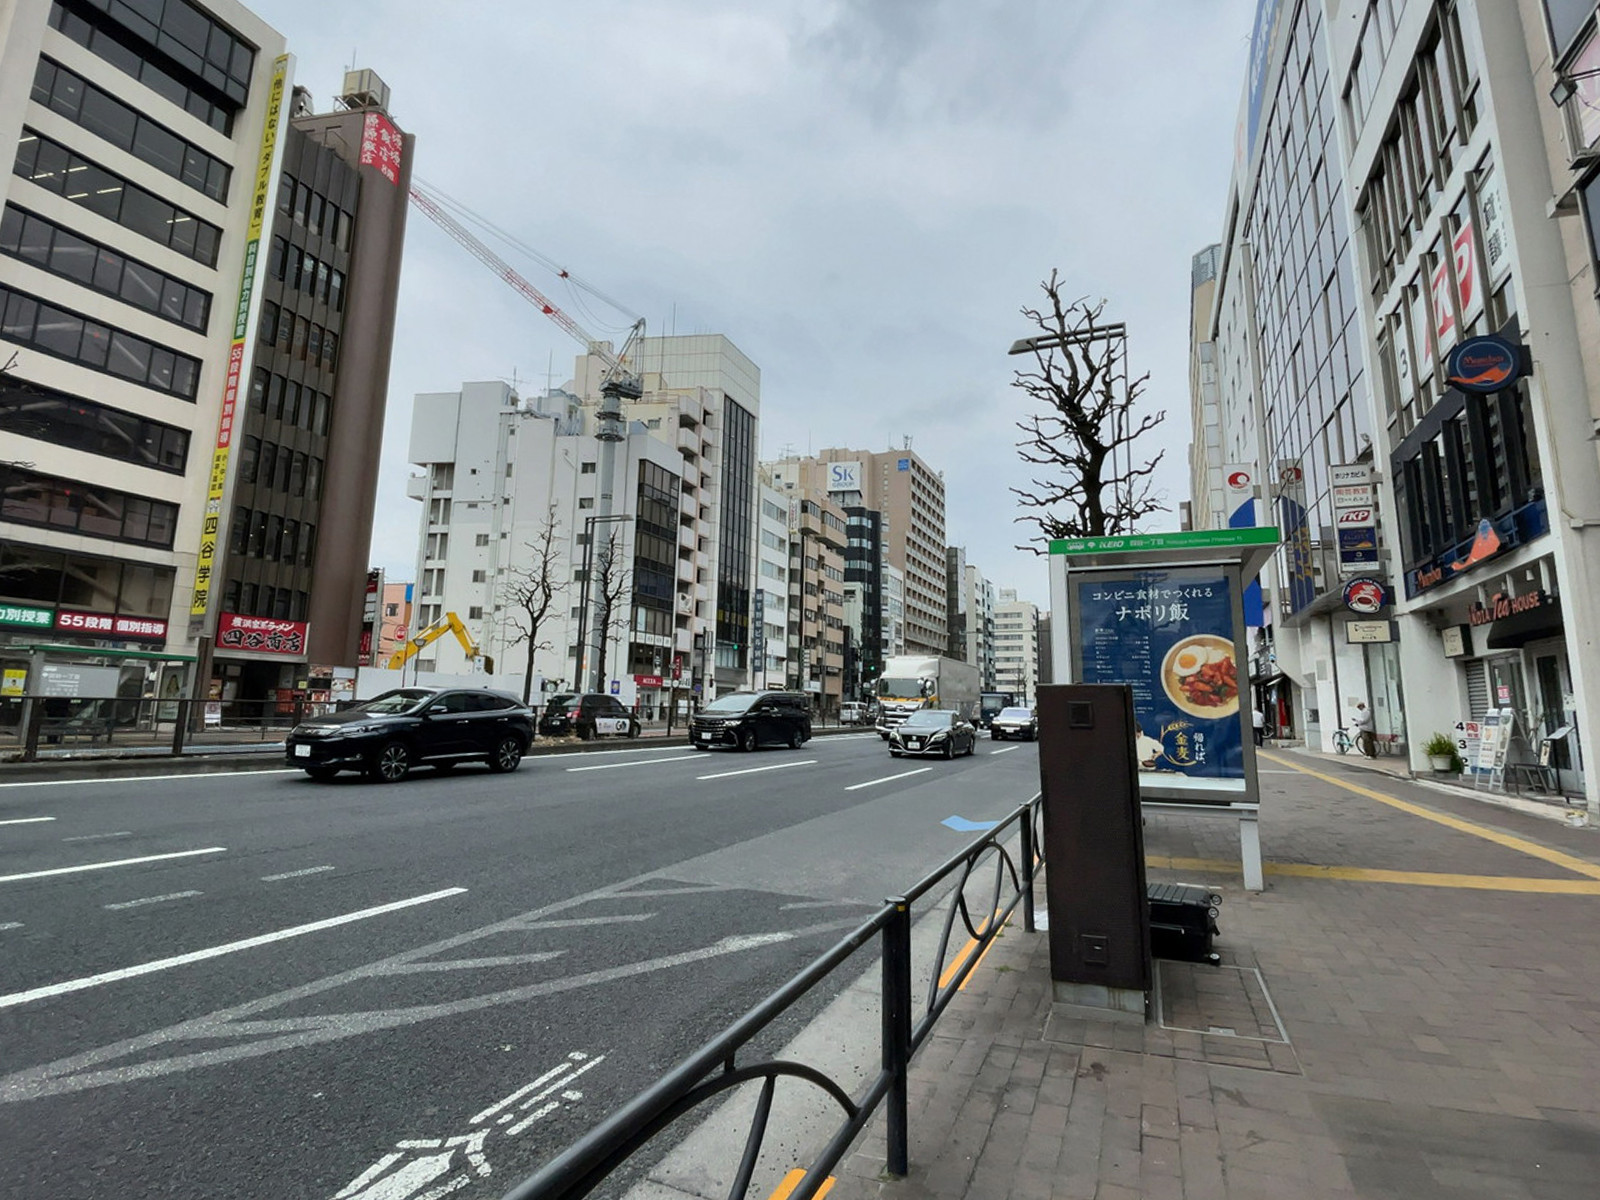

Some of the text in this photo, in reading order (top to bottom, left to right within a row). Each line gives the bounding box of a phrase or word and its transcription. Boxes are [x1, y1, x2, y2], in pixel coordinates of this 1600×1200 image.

[832, 465, 854, 482] SK
[1341, 510, 1369, 521] TKP
[192, 516, 219, 608] 四谷学院
[1092, 587, 1213, 601] コンビニ食材でつくれる
[1511, 591, 1541, 615] HOUSE
[1115, 603, 1190, 622] ナポリ飯
[59, 614, 113, 630] 55段階
[116, 619, 165, 635] 個別指導
[221, 628, 302, 652] 四谷商店
[1455, 722, 1465, 731] 4
[1174, 731, 1190, 761] 金麦
[1193, 732, 1206, 765] 帰れば、
[1458, 740, 1467, 749] 3
